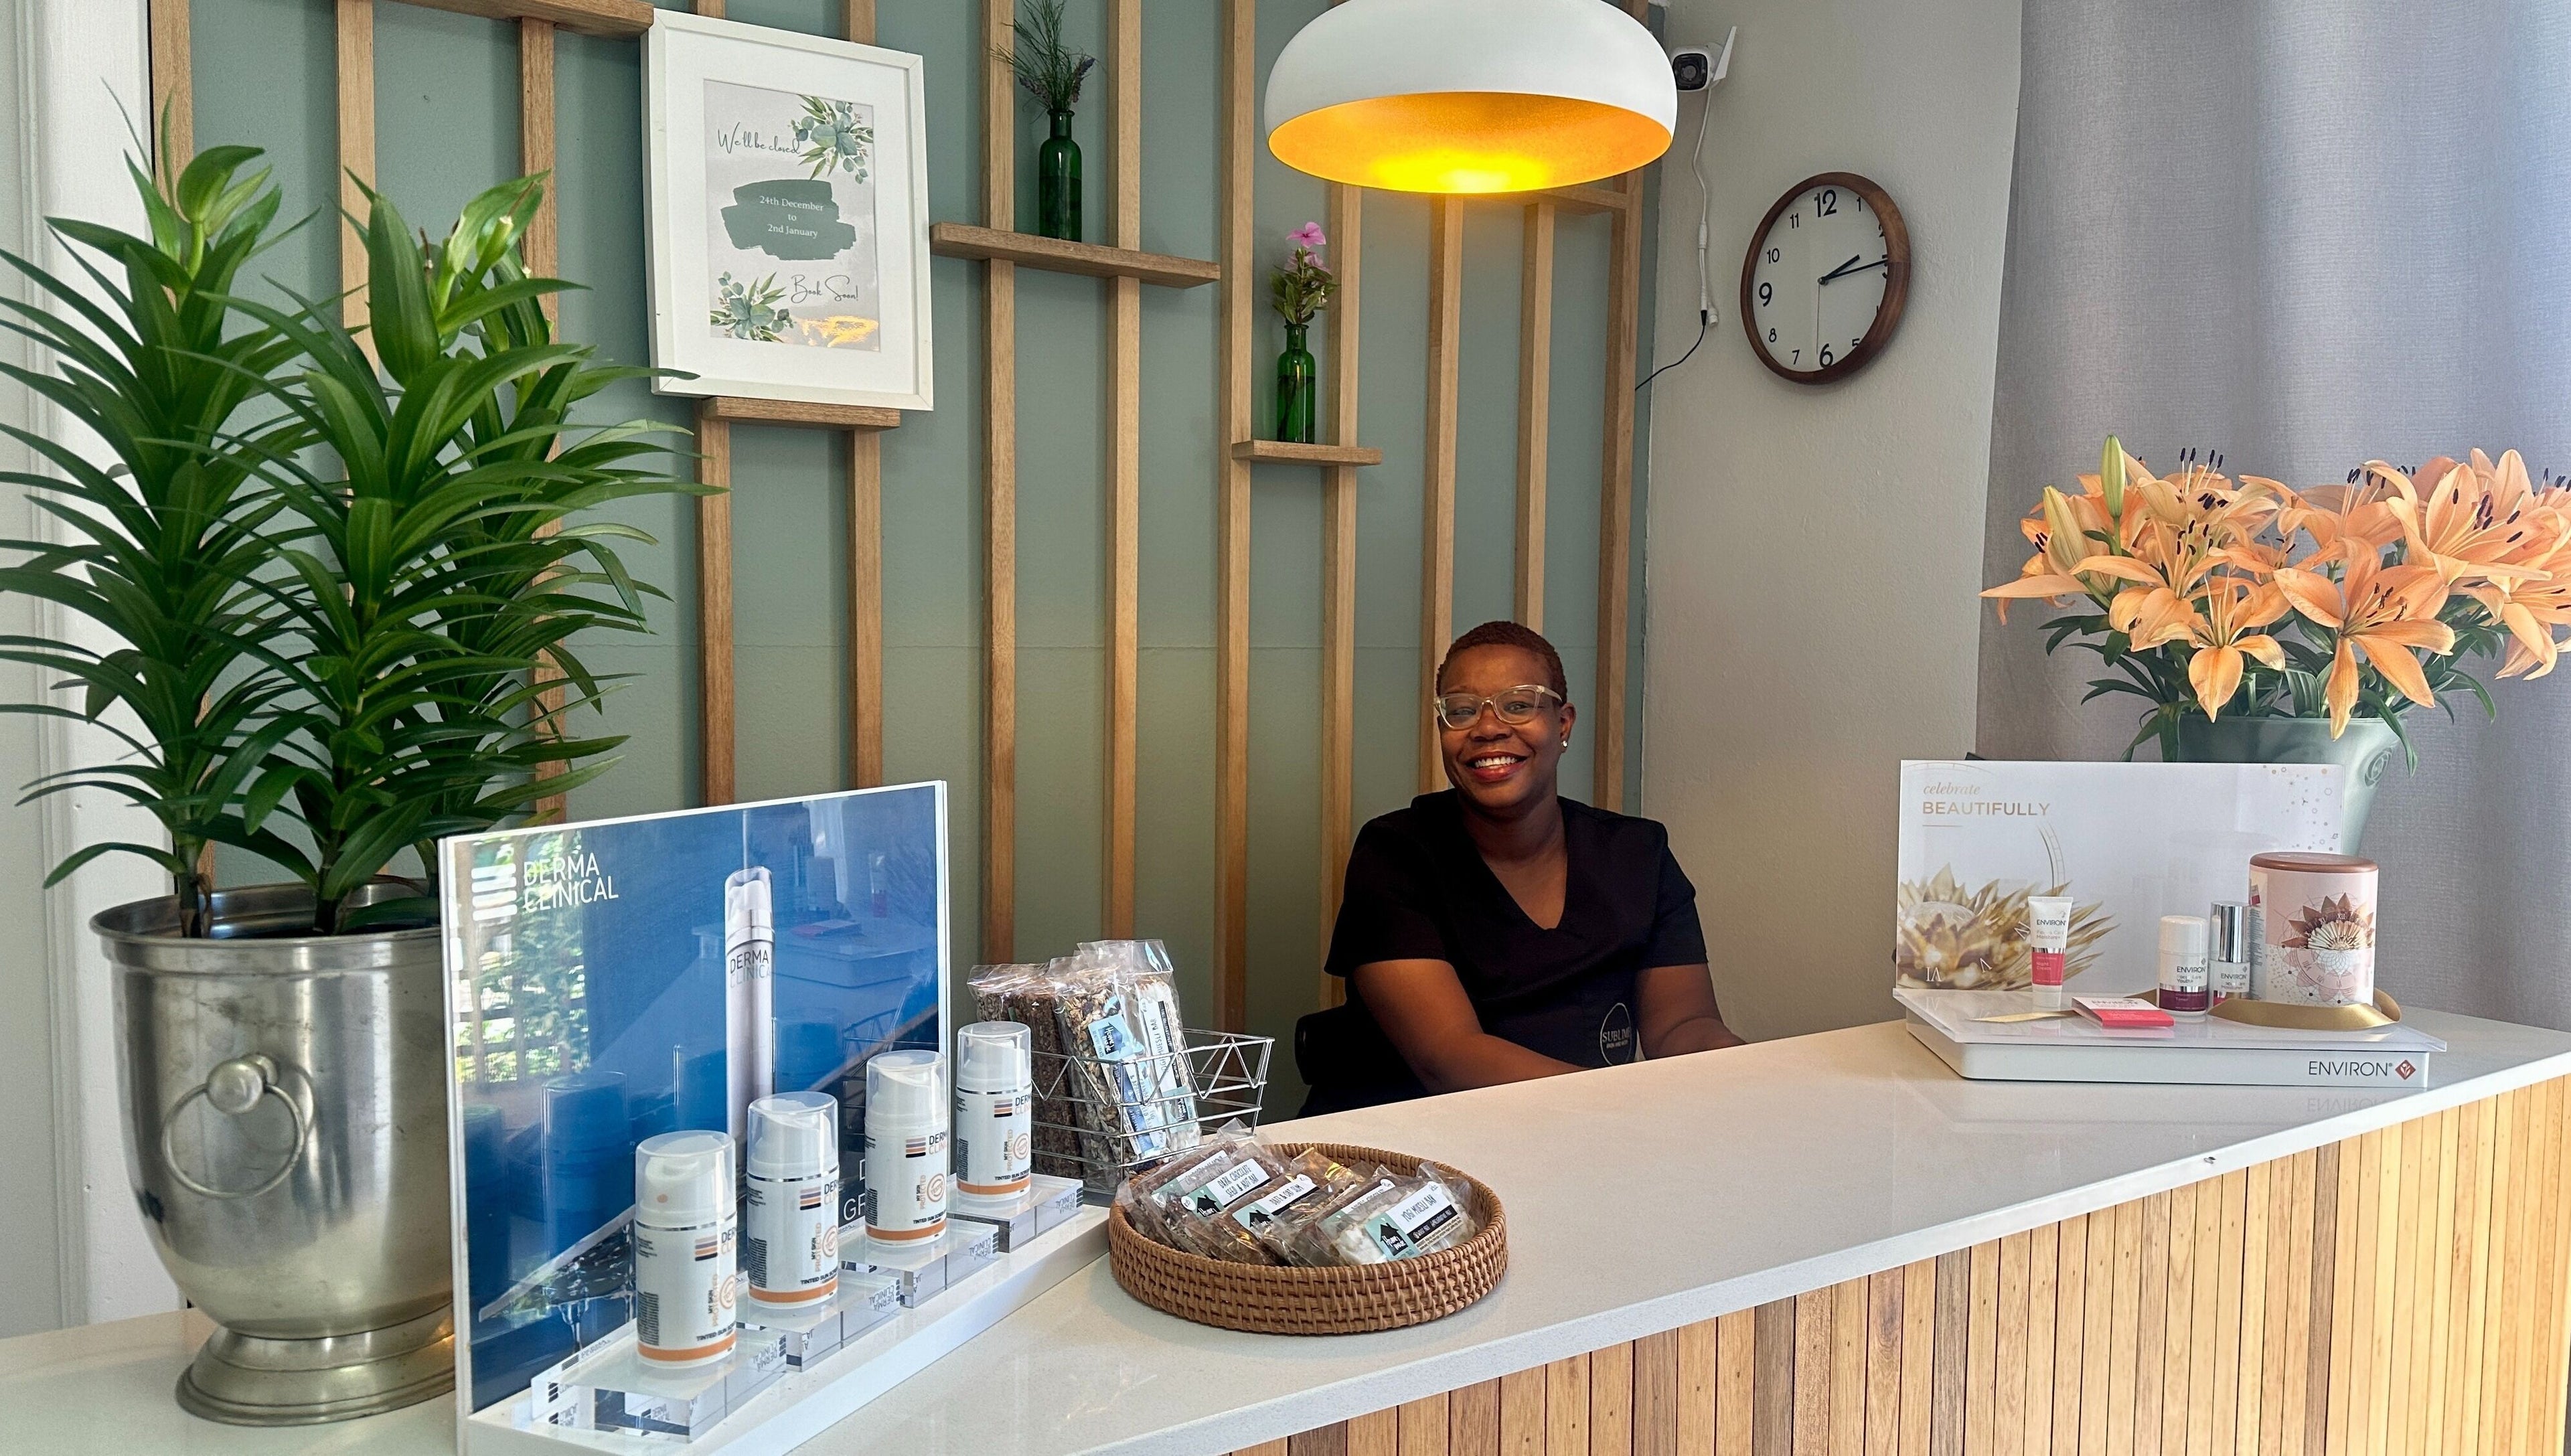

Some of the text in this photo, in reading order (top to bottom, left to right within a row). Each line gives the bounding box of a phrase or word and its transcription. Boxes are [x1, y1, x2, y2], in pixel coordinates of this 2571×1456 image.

[755, 132, 767, 148] be
[769, 136, 800, 154] closed
[759, 195, 824, 211] 24th December
[1814, 189, 1837, 218] 12
[1857, 197, 1861, 212] 1
[1790, 213, 1799, 229] 11
[767, 224, 818, 239] 2nd January
[1767, 248, 1780, 264] 10
[791, 274, 858, 304] Book Soon!
[1758, 282, 1772, 307] 9
[1768, 327, 1777, 343] 8
[1792, 349, 1800, 365] 7
[1819, 343, 1833, 369] 6
[1923, 782, 1981, 795] celebrate
[1922, 801, 2050, 816] BEAUTIFULLY
[524, 852, 600, 886] DERMA
[524, 876, 619, 913] CLINICAL
[730, 949, 769, 974] DERMA
[1217, 1176, 1231, 1189] DARK
